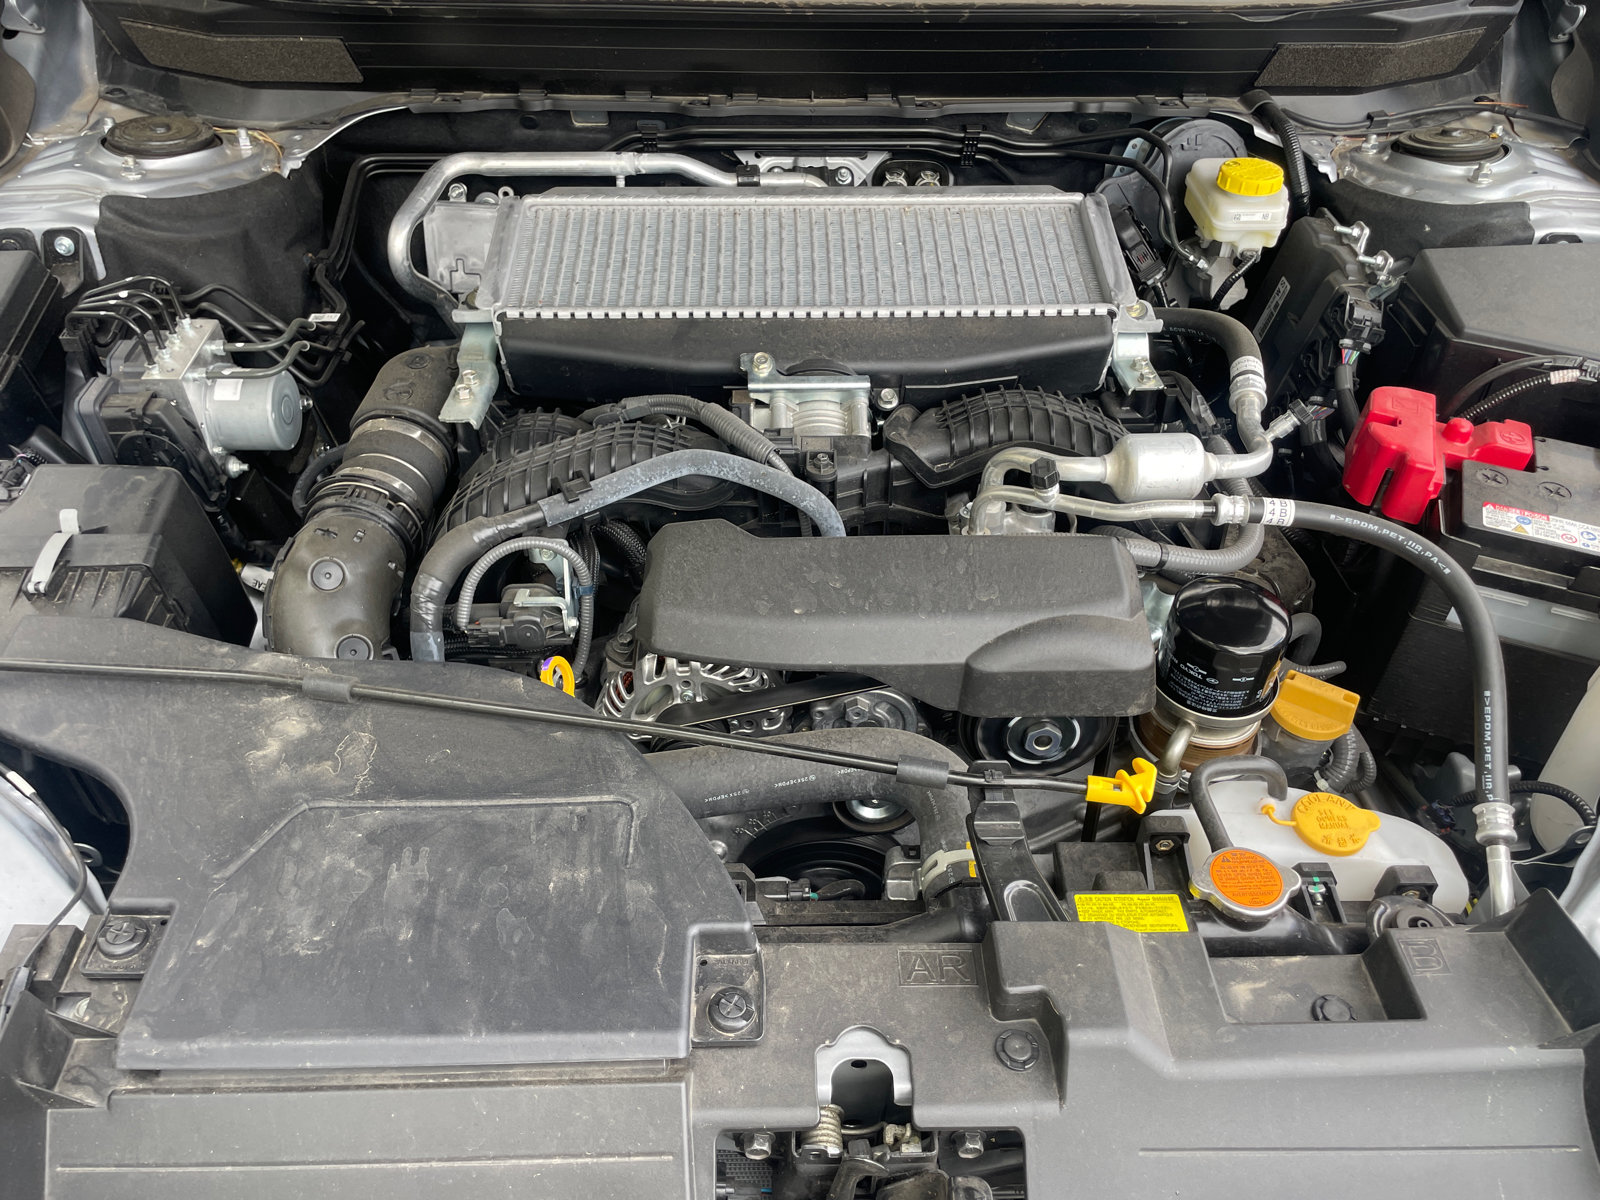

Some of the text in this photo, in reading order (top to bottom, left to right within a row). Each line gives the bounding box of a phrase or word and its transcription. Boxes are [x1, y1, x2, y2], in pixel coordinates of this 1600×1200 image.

[1268, 508, 1288, 518] 4 B
[1180, 663, 1203, 680] TOKYO
[906, 952, 971, 982] AR
[1399, 941, 1444, 972] B
